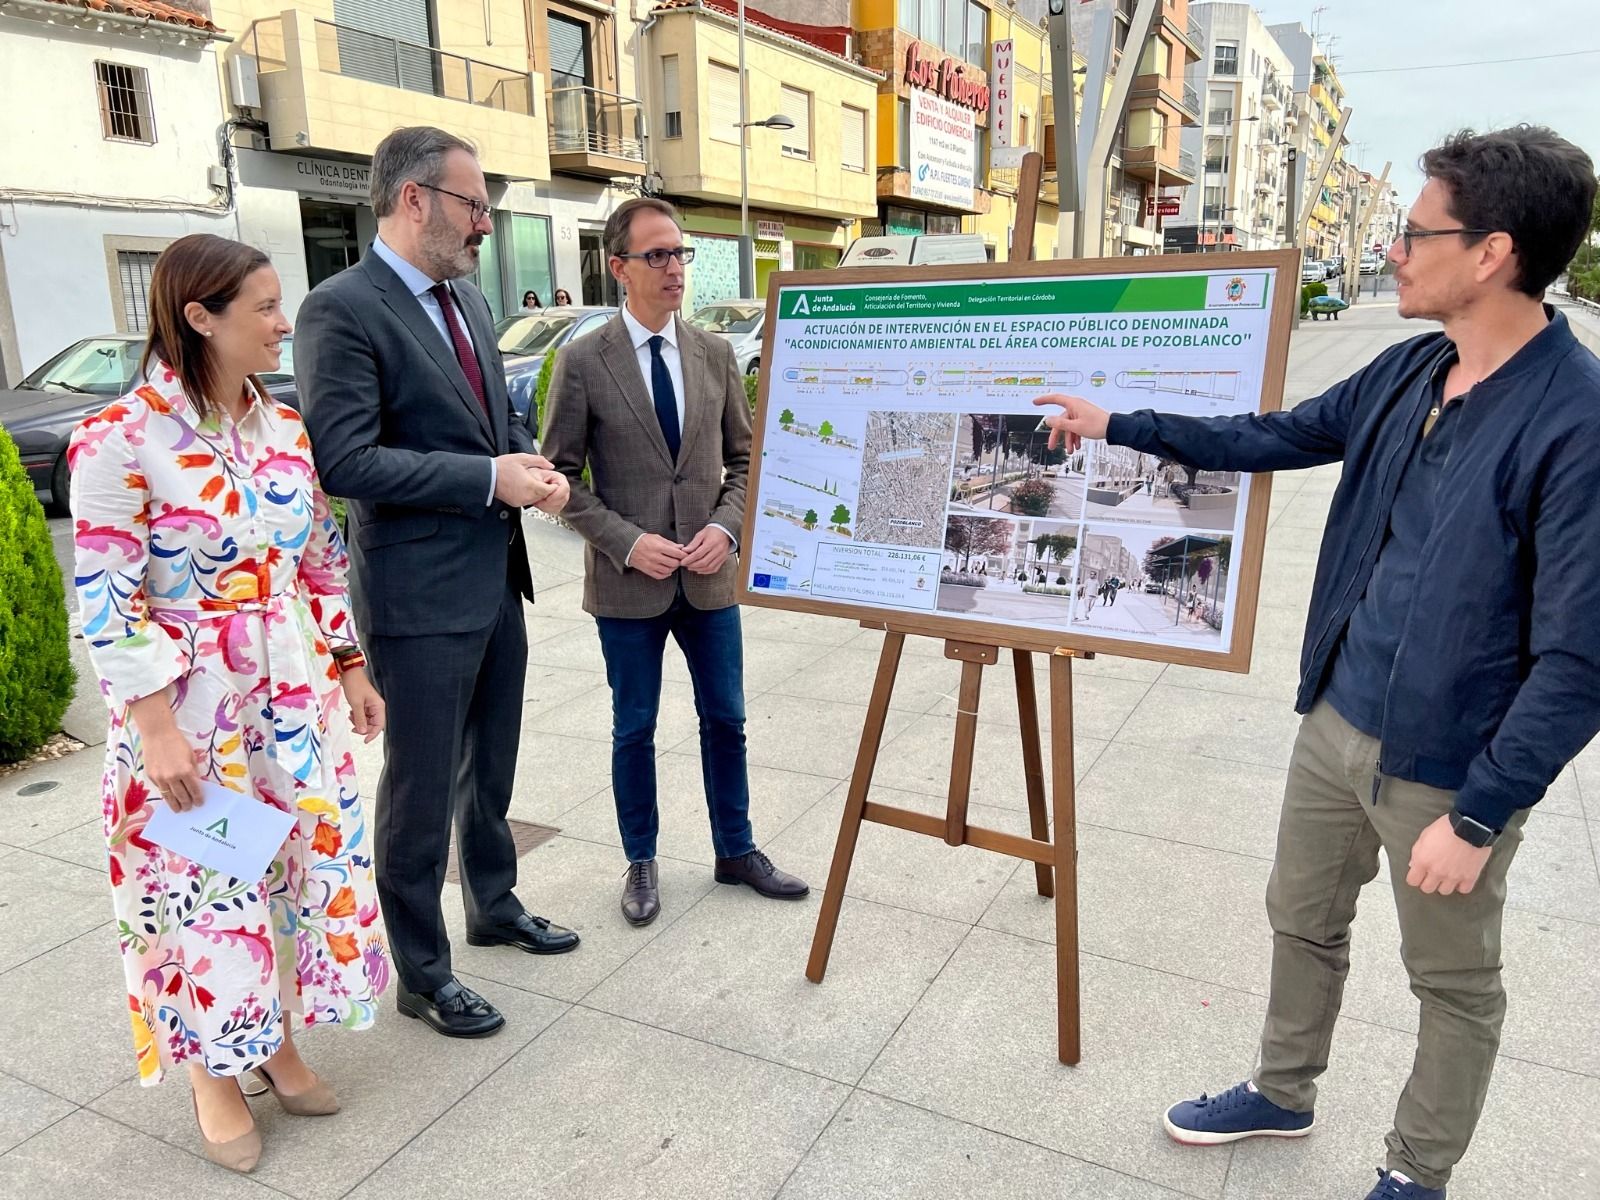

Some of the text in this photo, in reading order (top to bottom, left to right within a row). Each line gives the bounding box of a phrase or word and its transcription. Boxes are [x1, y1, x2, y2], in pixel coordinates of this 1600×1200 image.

[905, 41, 935, 86] Los
[918, 95, 971, 125] VENTA Y ALQUILER
[916, 111, 974, 142] EDIFICIO COMERCIAL
[297, 160, 369, 181] CLÍNICA DENT
[561, 226, 572, 240] 53
[813, 295, 833, 303] Junta
[864, 294, 892, 302] Consejería
[901, 293, 927, 302] Fomento,
[864, 301, 896, 310] Articulación
[896, 301, 905, 309] del
[906, 301, 931, 309] Territorio
[936, 300, 961, 309] Vivienda
[968, 295, 997, 304] Delegación
[997, 294, 1024, 302] Territorial
[1032, 293, 1056, 301] Córdoba
[812, 302, 856, 312] de Andalucía
[804, 317, 1229, 335] ACTUACIÓN DE INTERVENCIÓN EN EL ESPACIO PÚBLICO DENOMINADA
[784, 333, 1252, 350] "ACONDICIONAMIENTO AMBIENTAL DEL ÁREA COMERCIAL DE POZOBLANCO"
[888, 552, 921, 561] 228.131,06
[190, 826, 204, 836] Junta
[211, 836, 236, 849] Andalucía
